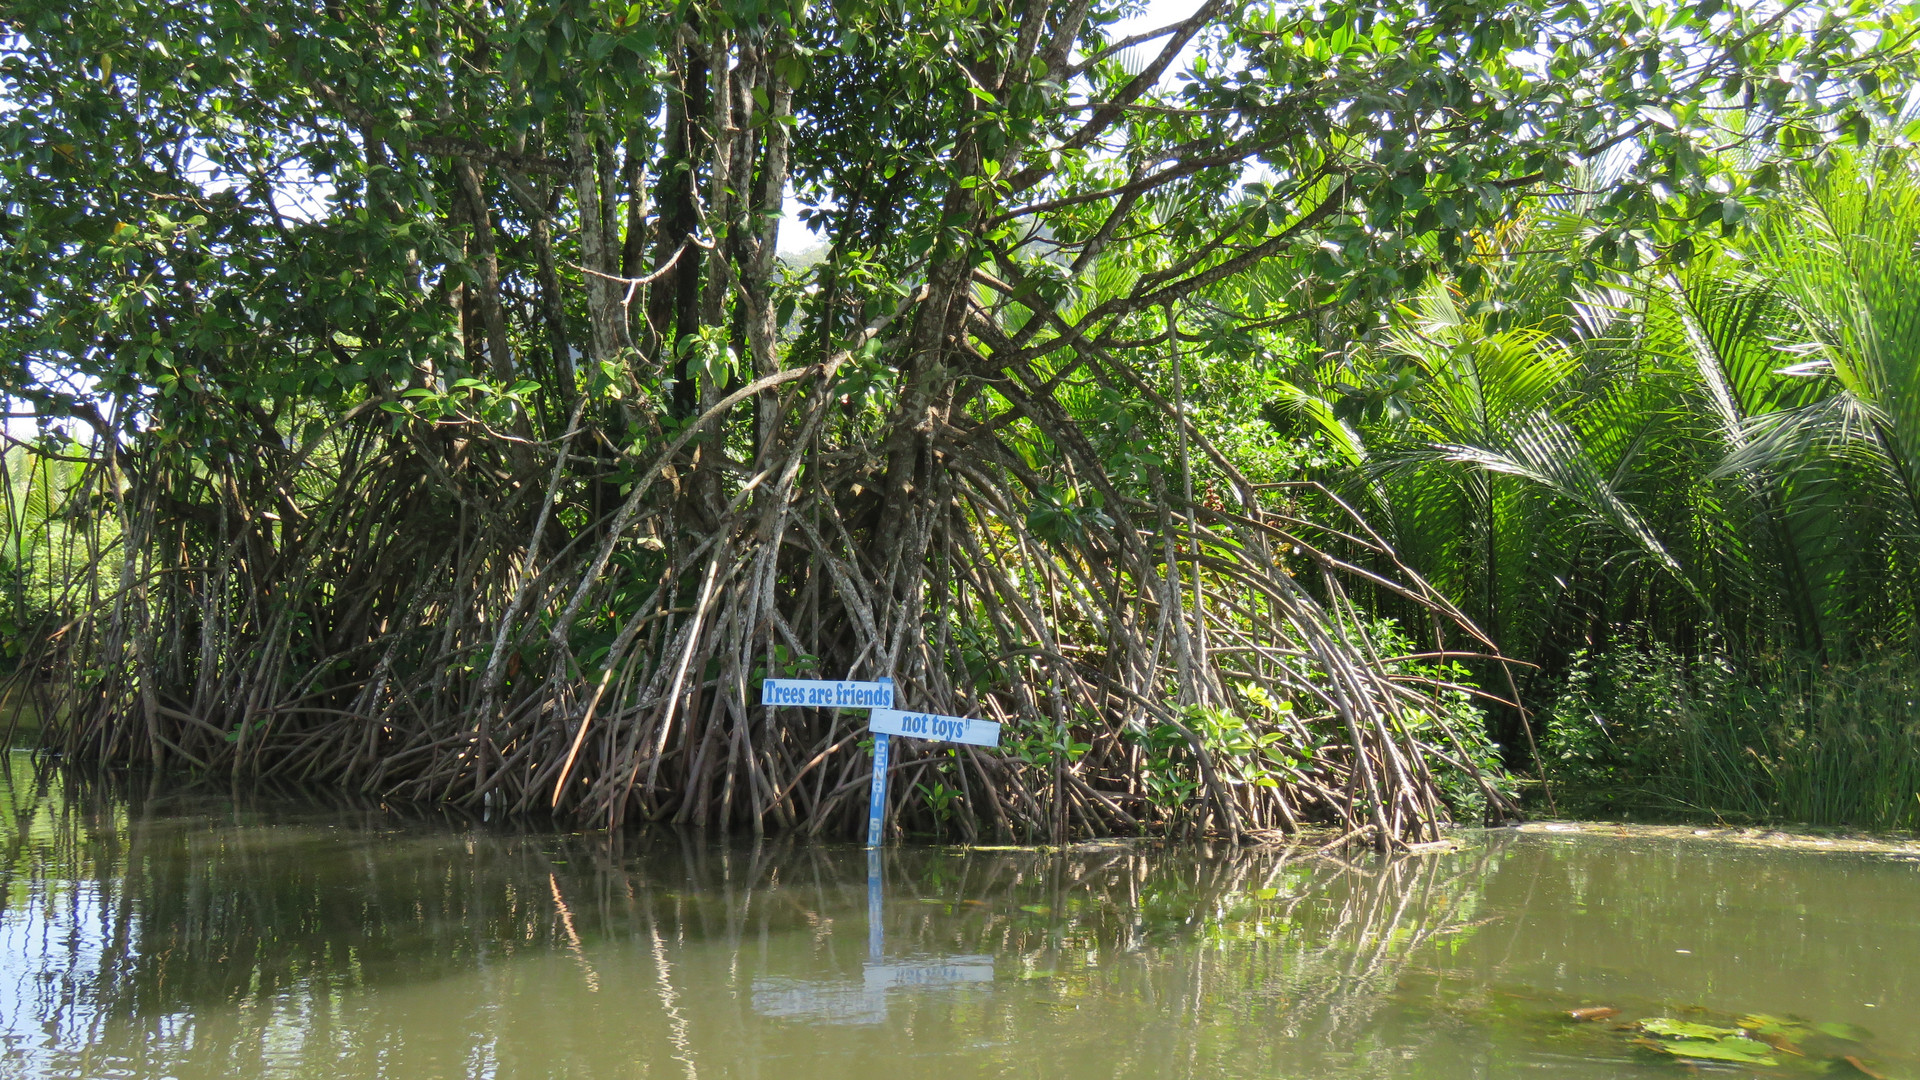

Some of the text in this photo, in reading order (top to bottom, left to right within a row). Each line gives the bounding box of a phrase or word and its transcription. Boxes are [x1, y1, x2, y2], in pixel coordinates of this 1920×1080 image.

[765, 680, 890, 706] Trees are friends
[901, 714, 928, 734] not
